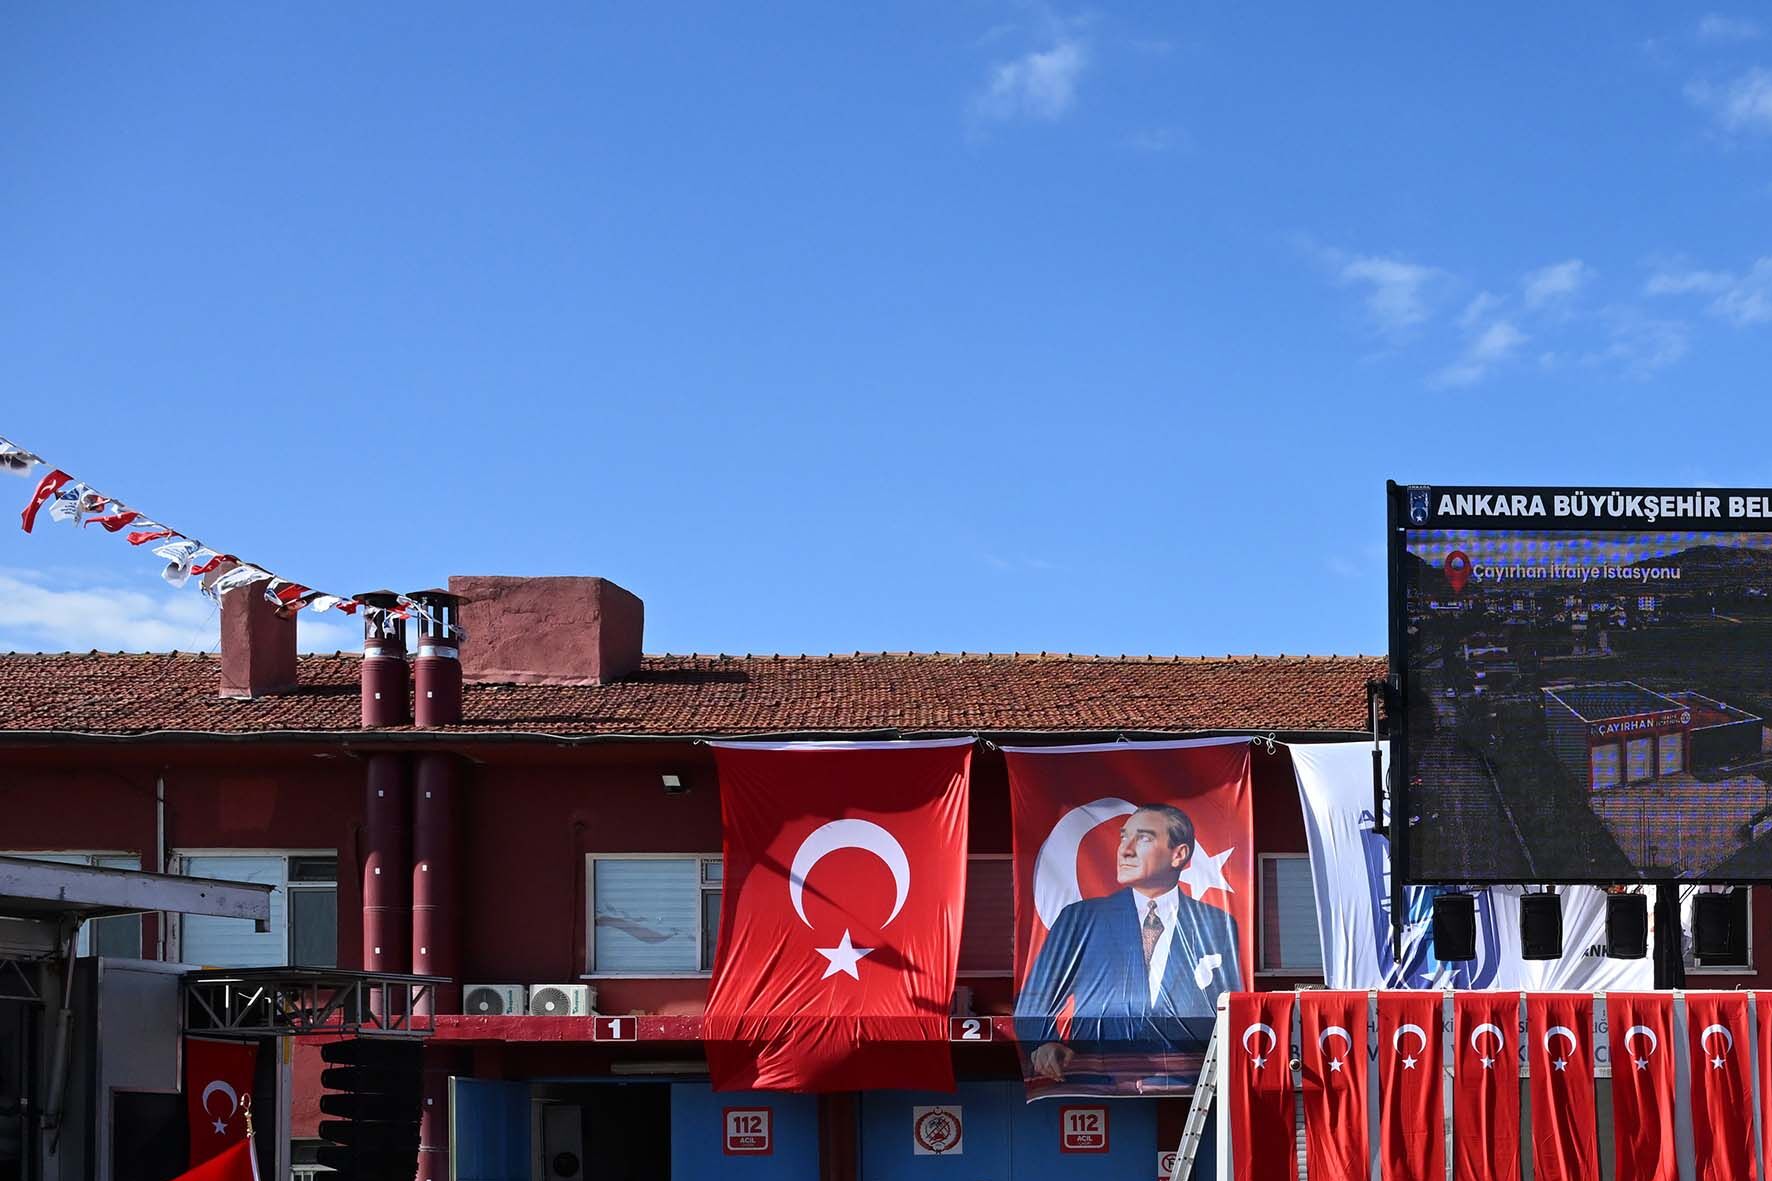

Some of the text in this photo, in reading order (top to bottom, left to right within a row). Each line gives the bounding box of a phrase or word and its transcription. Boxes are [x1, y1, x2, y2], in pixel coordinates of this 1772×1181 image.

[1437, 494, 1547, 517] ANKARA
[1553, 490, 1722, 523] BÜYÜKŞEHİR
[1472, 563, 1547, 583] Çayırhan
[1603, 563, 1681, 583] İstasyonu
[1598, 719, 1654, 736] ÇAYIRHAN
[607, 1018, 622, 1039] 1
[962, 1019, 981, 1040] 2
[733, 1115, 762, 1134] 112
[1070, 1113, 1099, 1132] 112
